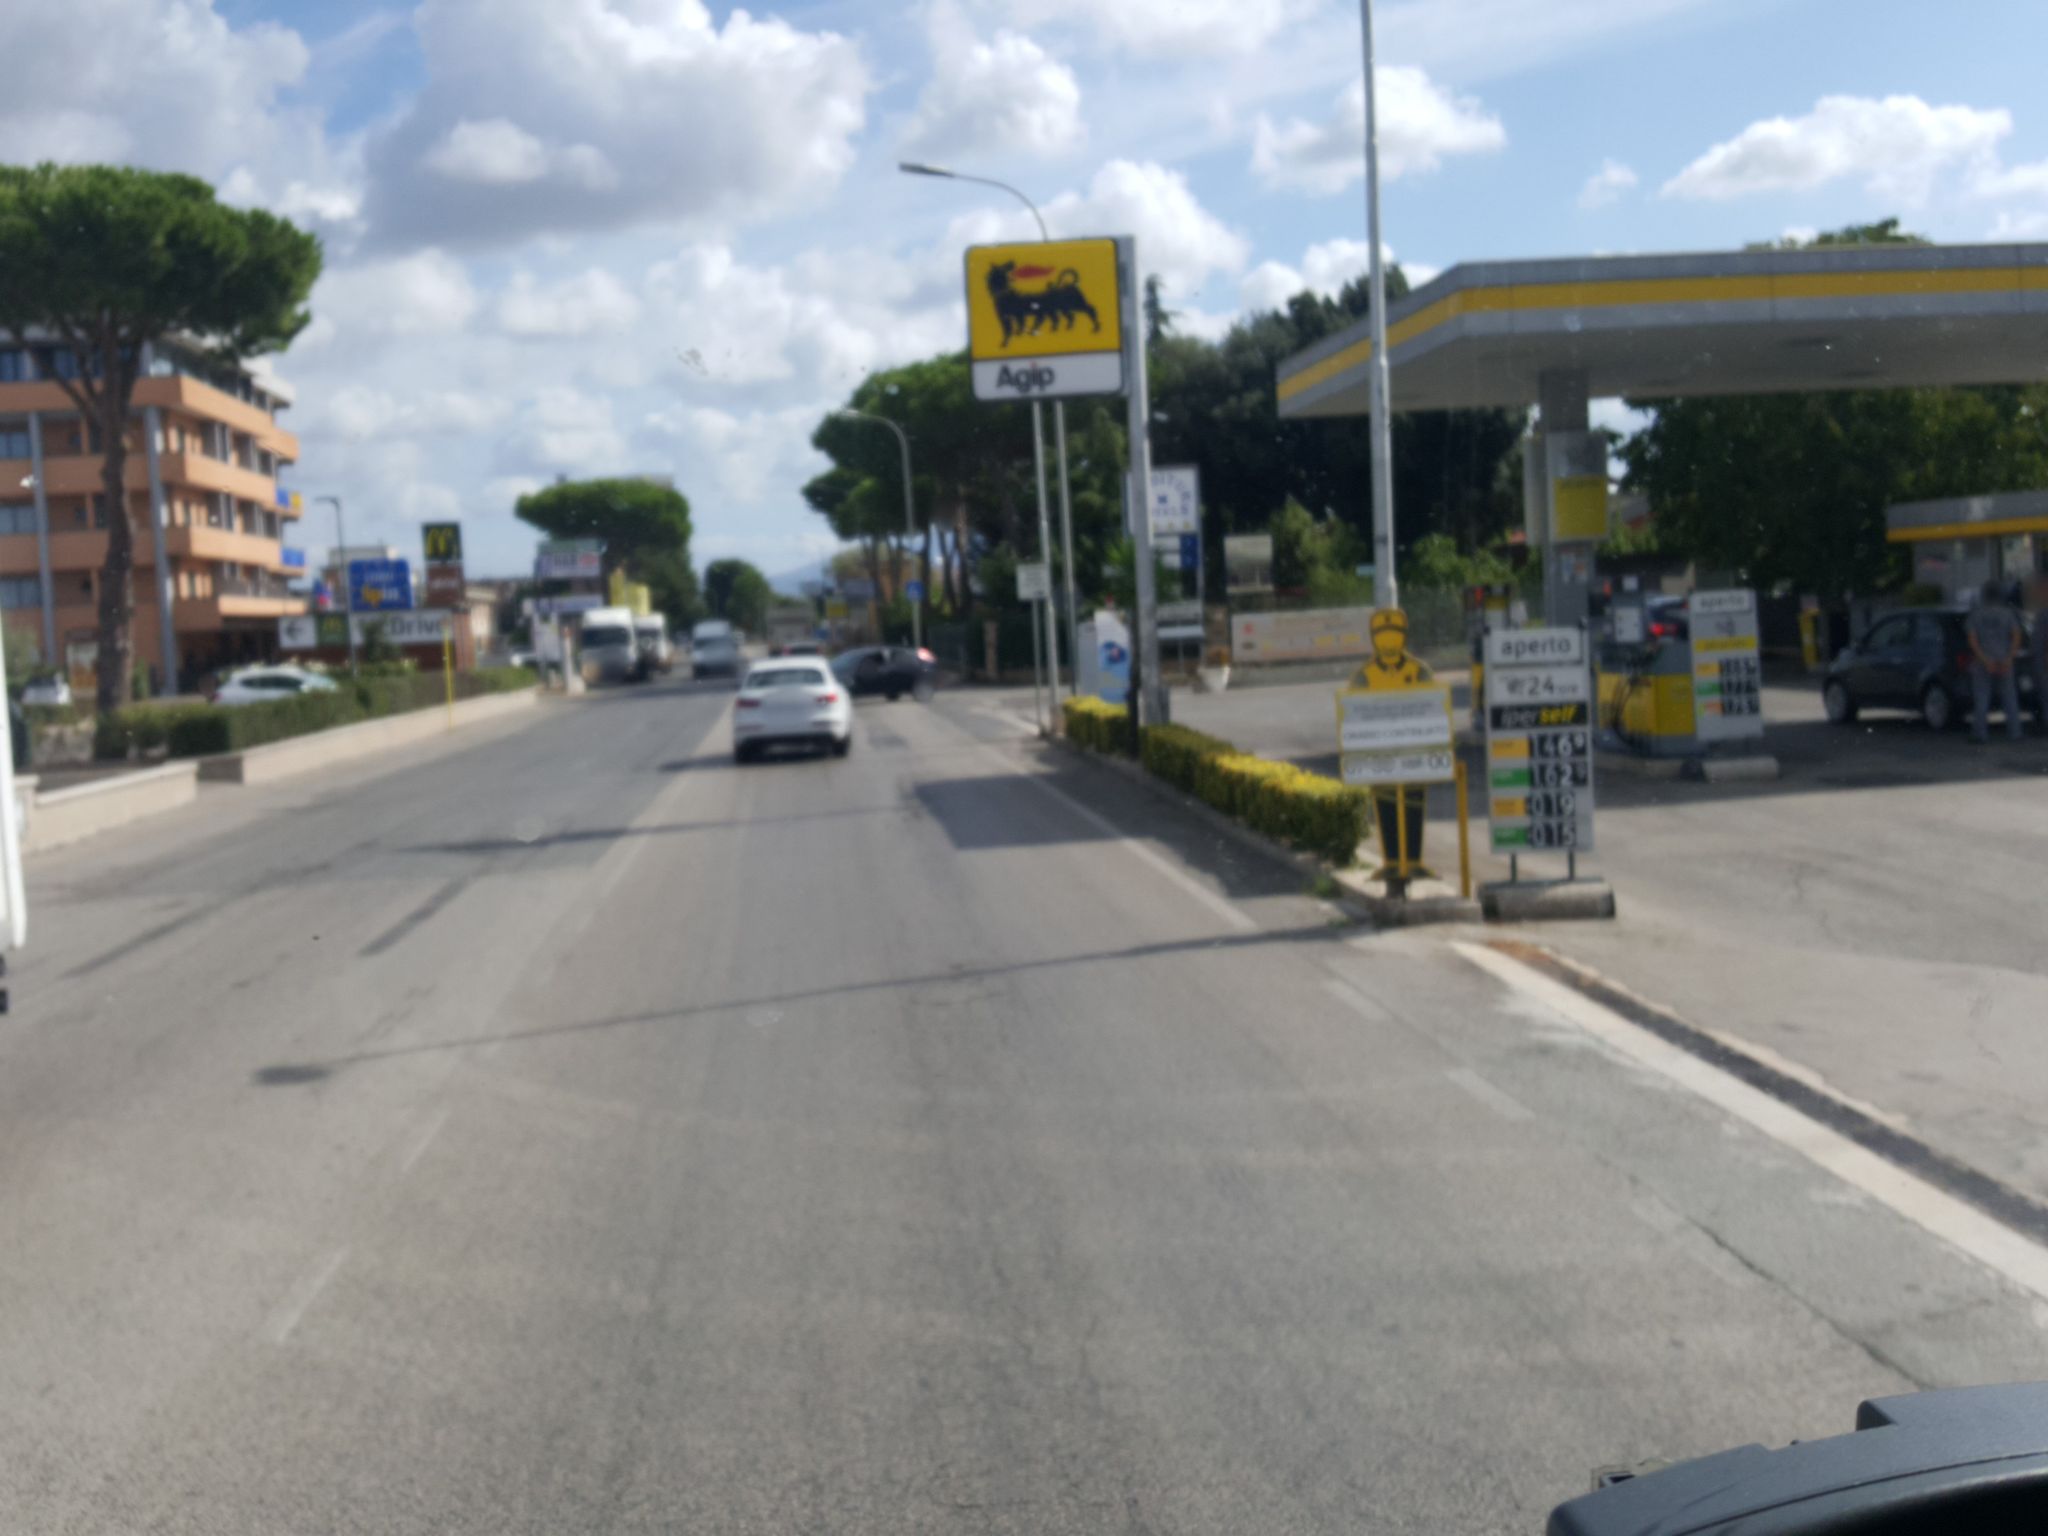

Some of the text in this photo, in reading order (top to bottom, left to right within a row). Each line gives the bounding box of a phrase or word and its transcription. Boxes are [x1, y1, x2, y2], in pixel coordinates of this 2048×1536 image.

[996, 361, 1055, 393] Agip
[1502, 636, 1571, 659] aperto
[1527, 675, 1554, 696] 24
